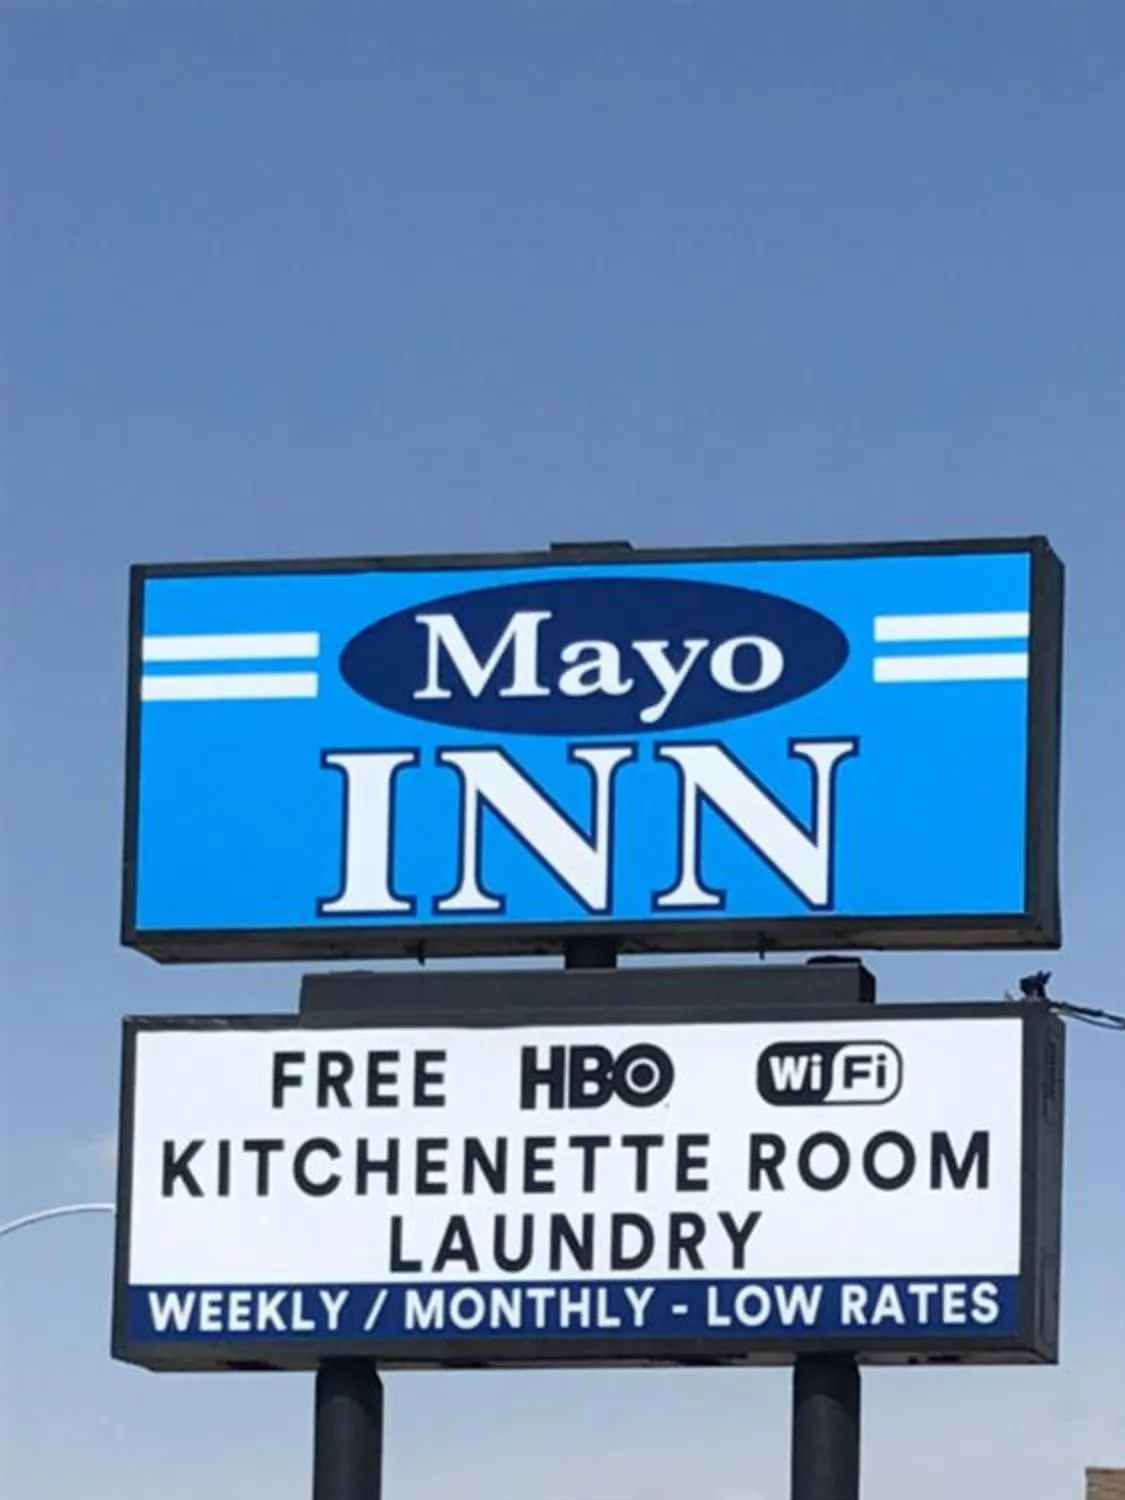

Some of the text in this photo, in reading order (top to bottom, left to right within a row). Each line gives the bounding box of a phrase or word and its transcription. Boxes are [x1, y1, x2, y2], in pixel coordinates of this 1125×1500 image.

[412, 609, 786, 723] Mayo
[317, 736, 860, 917] INN
[271, 1050, 447, 1109] FREE
[520, 1043, 675, 1110] HBO
[161, 1130, 990, 1197] KITCHENETTE ROOM
[389, 1211, 762, 1273] LAUNDRY
[148, 1290, 349, 1332] WEEKLY
[405, 1286, 655, 1329] MONTHLY
[707, 1284, 823, 1327] LOW
[841, 1281, 999, 1325] RATES
